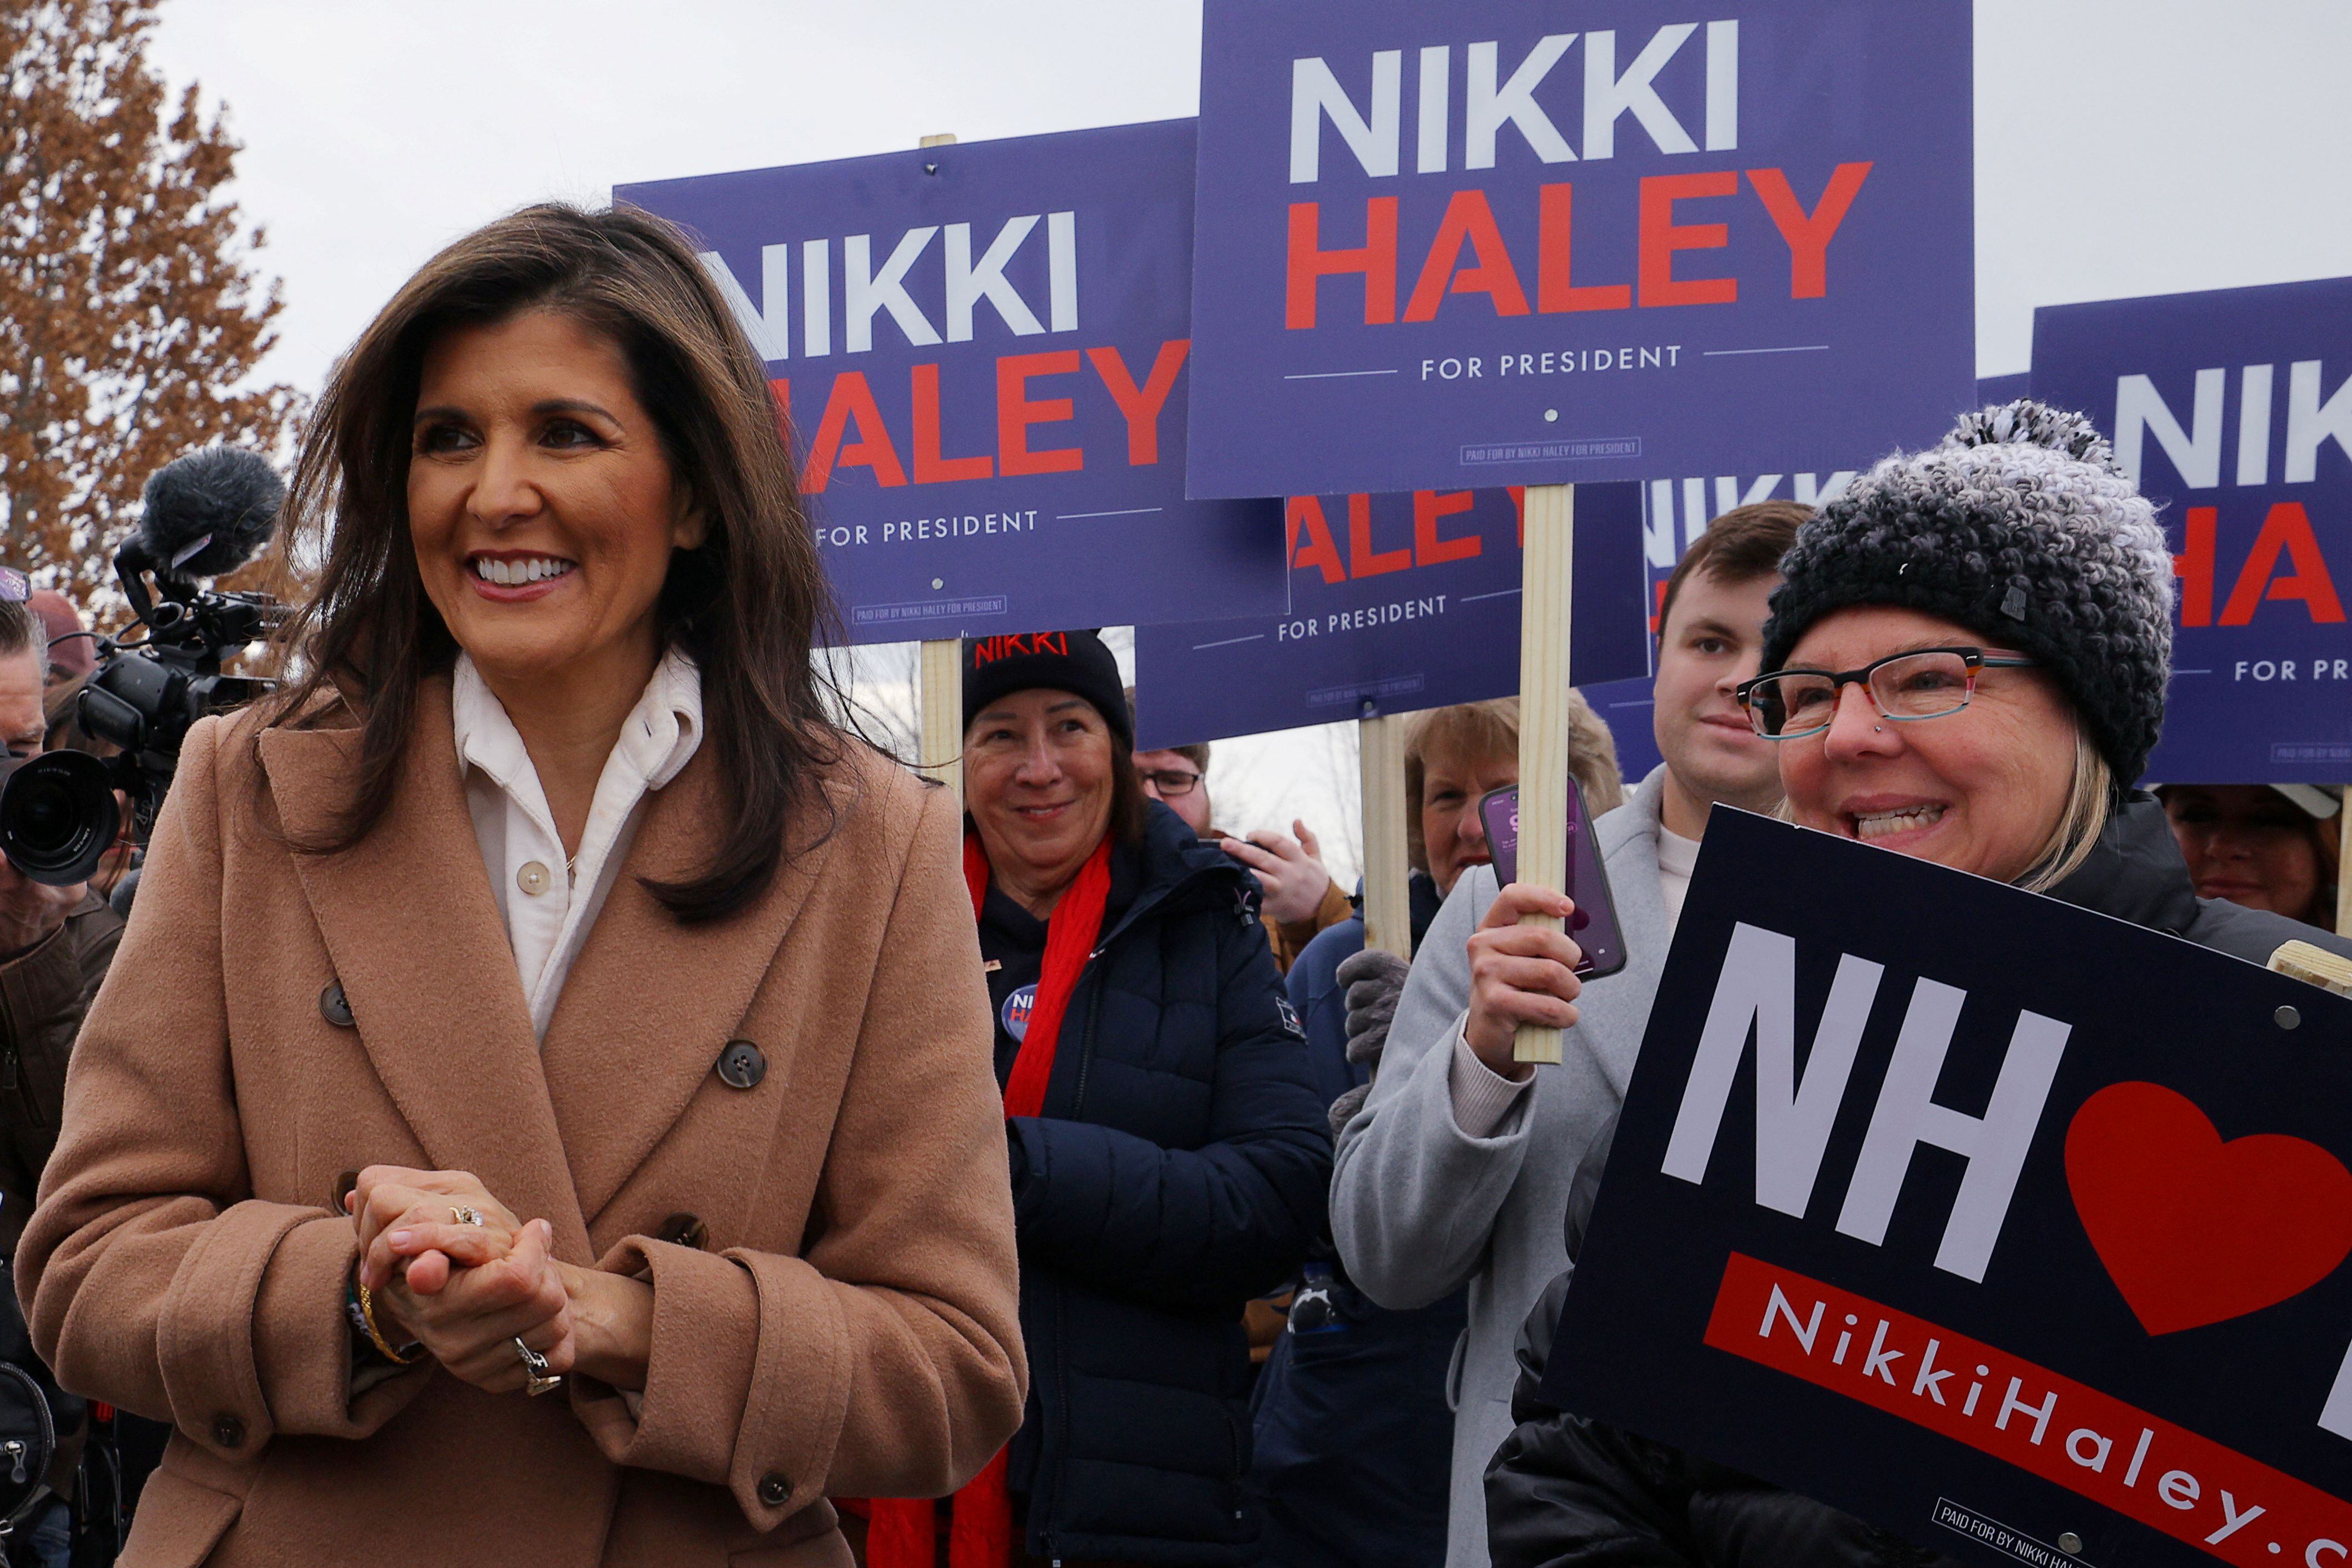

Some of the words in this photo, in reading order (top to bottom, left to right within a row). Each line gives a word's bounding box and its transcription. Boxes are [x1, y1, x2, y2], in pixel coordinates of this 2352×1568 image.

[1289, 19, 1739, 183] NIKKI
[1286, 162, 1873, 330] HALEY
[696, 211, 1078, 361] NIKKI
[1422, 357, 1483, 381] FOR
[1500, 345, 1681, 376] PRESIDENT
[768, 340, 1190, 494] ALEY
[1466, 450, 1486, 460] PAID
[1487, 449, 1503, 460] FOR
[1505, 448, 1516, 459] BY
[1518, 447, 1541, 458] NIKKI
[1544, 445, 1570, 457] HALEY
[1571, 444, 1588, 456] FOR
[1590, 442, 1636, 455] PRESIDENT
[816, 525, 869, 547] FOR
[883, 510, 1038, 542] PRESIDENT
[856, 609, 874, 621] PAID
[875, 608, 889, 619] FOR
[890, 608, 900, 618] BY
[901, 606, 921, 617] NIKKI
[922, 604, 945, 616] HALEY
[947, 603, 961, 614] FOR
[963, 600, 1002, 613] PRESIDENT
[1278, 618, 1318, 642] FOR
[1328, 595, 1447, 633] PRESIDENT
[975, 631, 1068, 669] NIKKI
[2235, 660, 2296, 681] FOR
[2313, 659, 2348, 680] PR
[1010, 1008, 1031, 1023] H
[1661, 921, 2073, 1284] NH
[1758, 1282, 2348, 1568] NikkiHaley.c
[1941, 1507, 1969, 1529] PAID
[1970, 1520, 1996, 1541] FOR
[1996, 1531, 2015, 1549] BY
[2014, 1540, 2049, 1566] NIKKI
